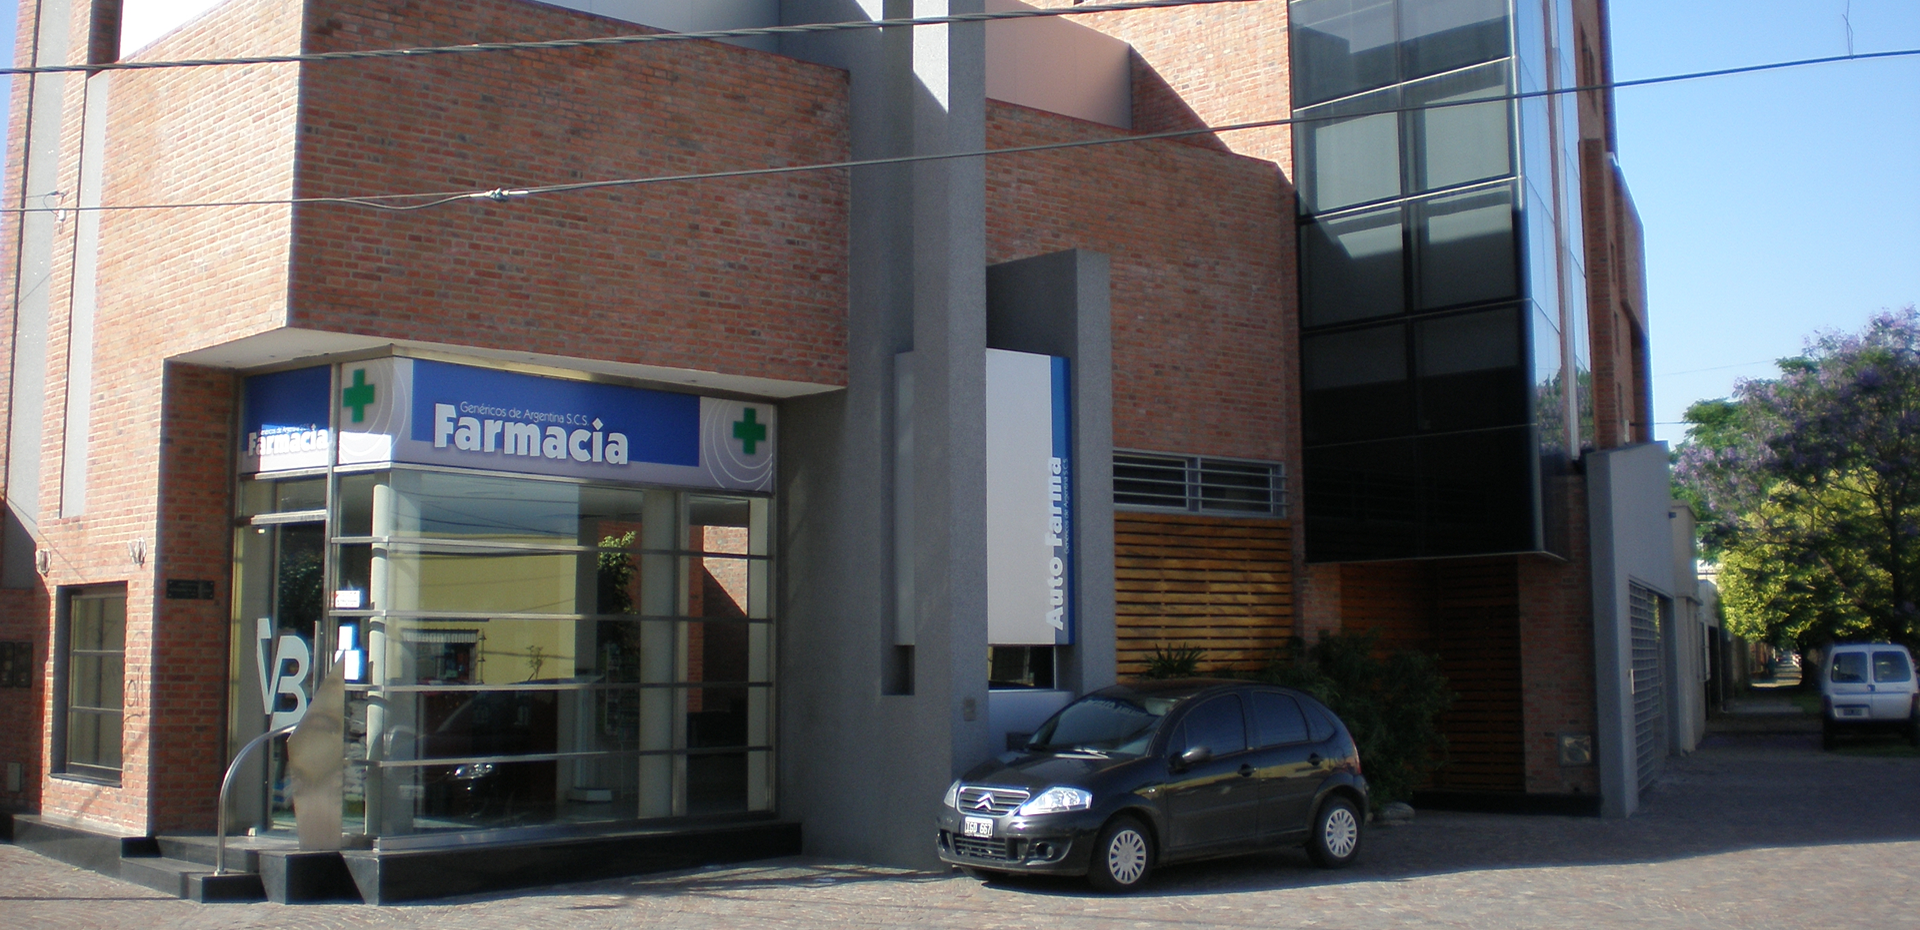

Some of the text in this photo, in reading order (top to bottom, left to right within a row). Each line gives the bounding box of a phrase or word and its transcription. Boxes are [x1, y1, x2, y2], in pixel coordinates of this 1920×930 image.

[434, 403, 629, 465] Farmacia
[459, 400, 590, 427] Genéricos de Argentina S.C.S.
[248, 423, 329, 457] Farmacia
[1044, 457, 1064, 631] Auto Farma
